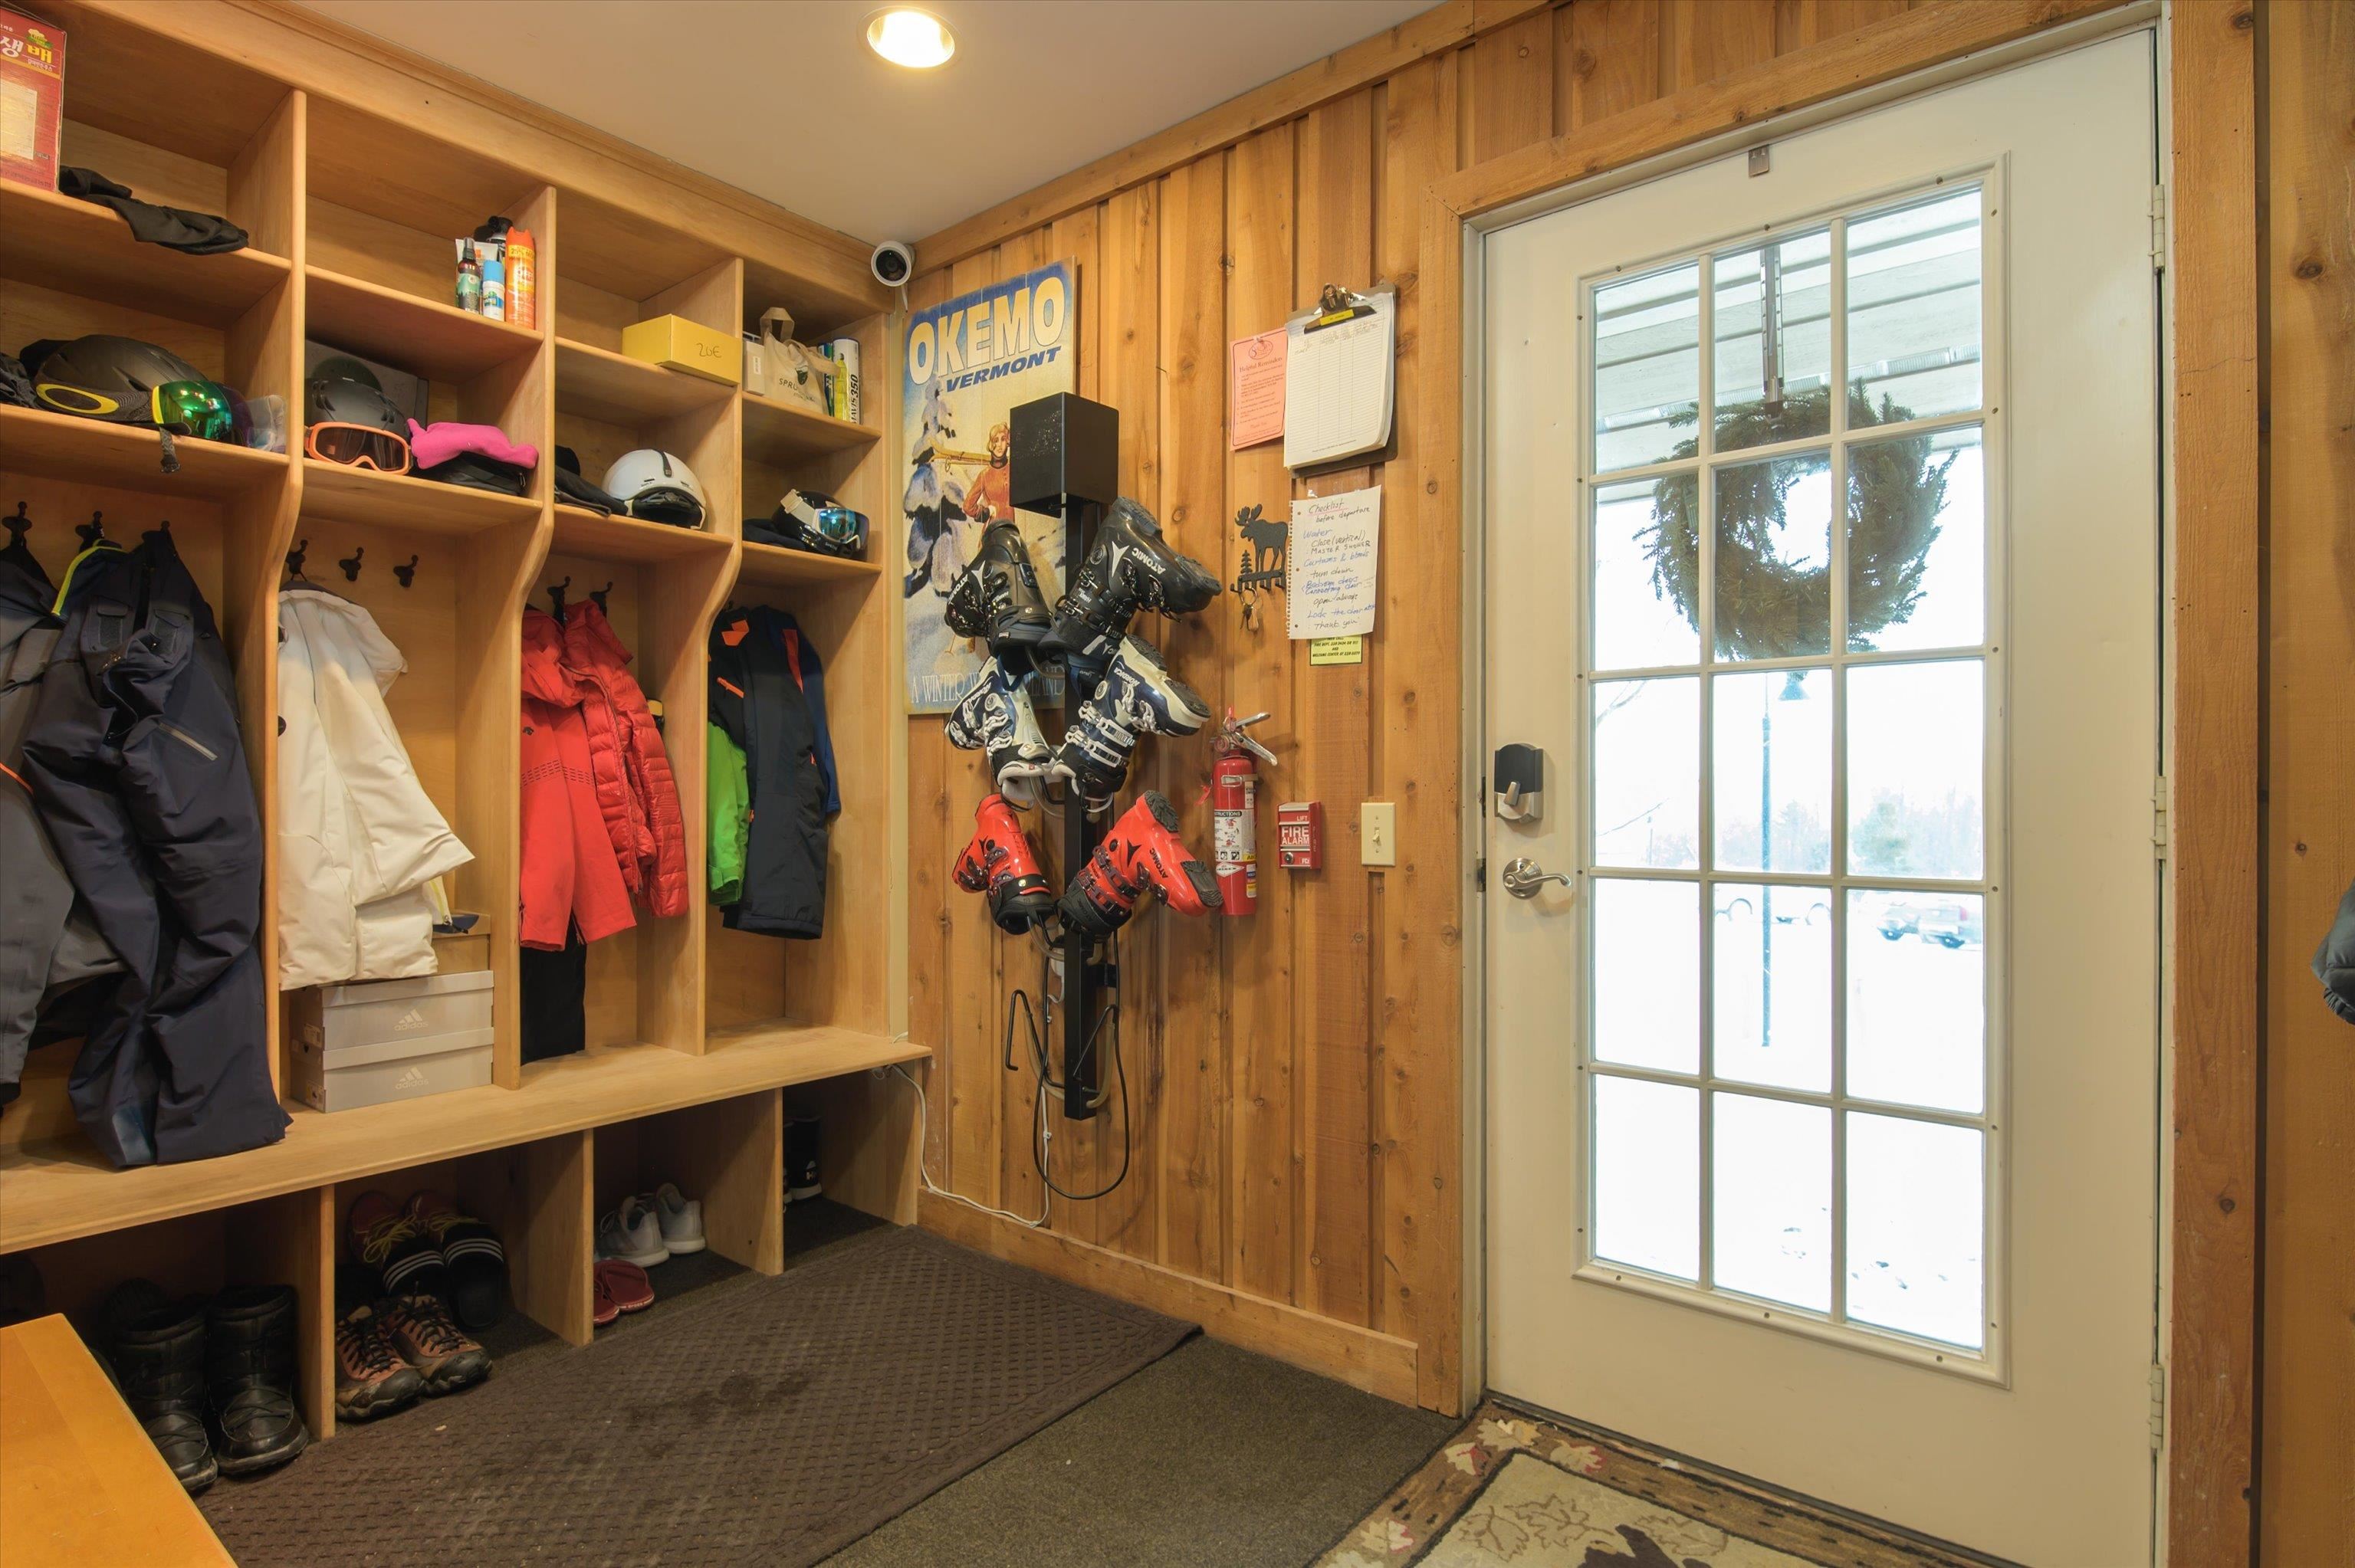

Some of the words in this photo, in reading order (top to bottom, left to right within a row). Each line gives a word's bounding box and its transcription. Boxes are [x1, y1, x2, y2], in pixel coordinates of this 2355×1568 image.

[908, 277, 1065, 385] OKEMO
[946, 346, 1062, 392] VERMONT
[850, 374, 859, 398] 350
[1309, 498, 1345, 514] Checklist
[1315, 514, 1335, 523] before
[1338, 507, 1371, 520] departure
[1303, 529, 1332, 539] Water
[1132, 547, 1166, 575] ATOMIC
[911, 676, 920, 704] A
[922, 672, 963, 704] WINTER
[1281, 826, 1309, 838] FIRE
[1149, 848, 1168, 879] ATOMIC
[394, 1020, 429, 1032] adidas
[395, 1078, 429, 1091] adidas
